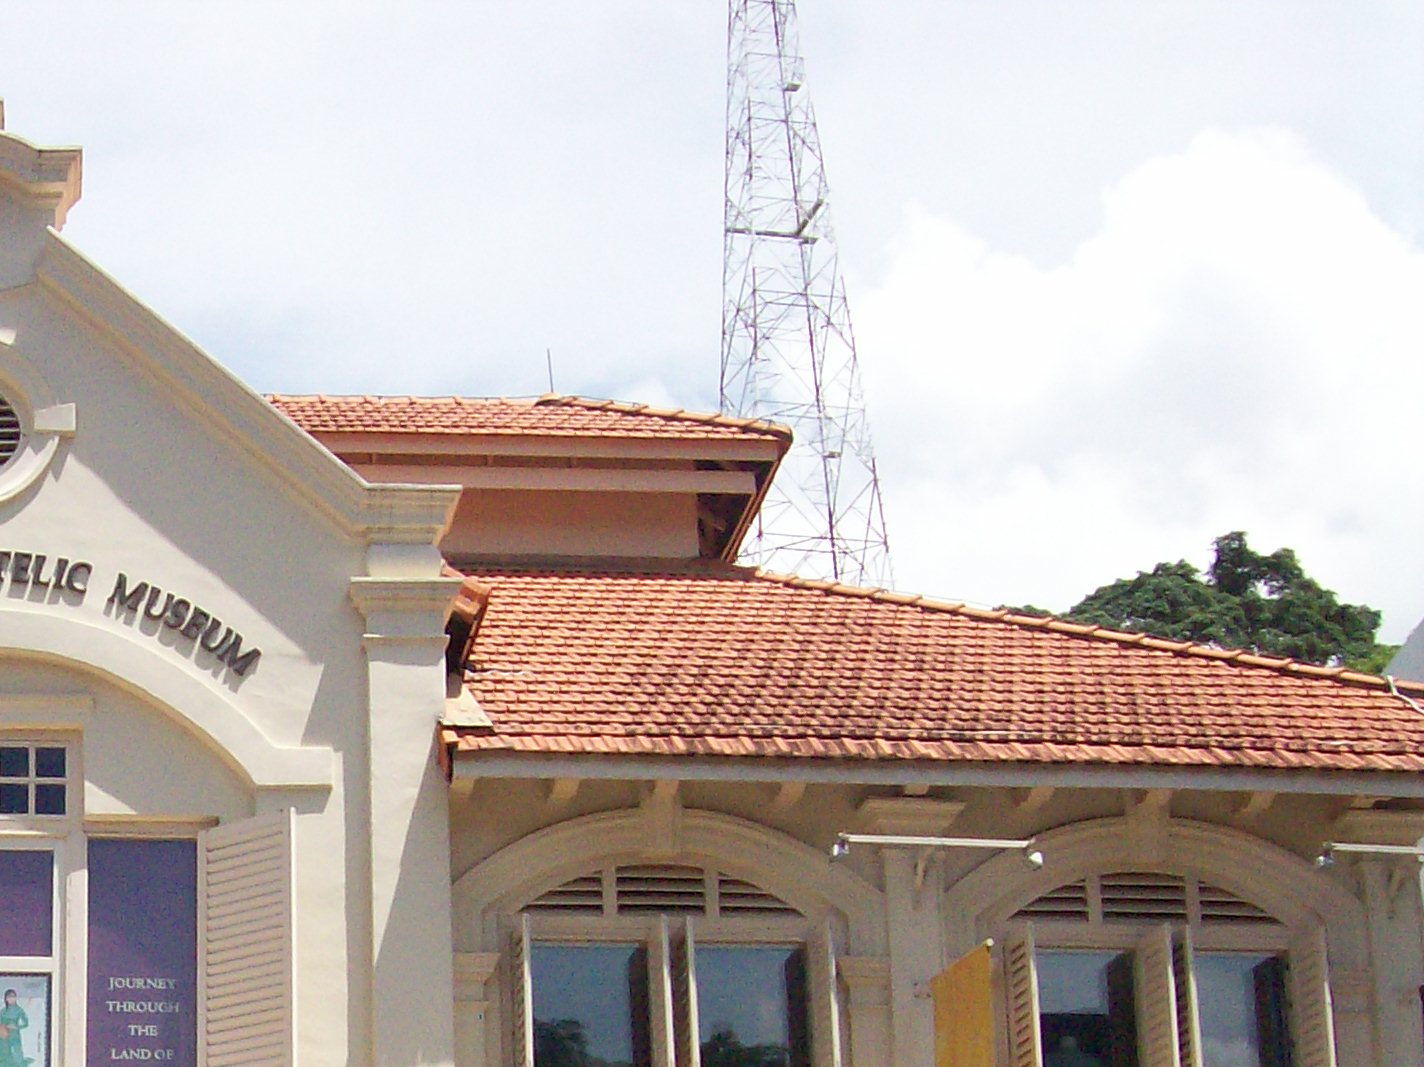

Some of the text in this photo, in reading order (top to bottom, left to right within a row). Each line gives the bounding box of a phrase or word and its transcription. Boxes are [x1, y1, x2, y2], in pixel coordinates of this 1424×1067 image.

[109, 572, 263, 678] MUSEUM
[107, 977, 177, 991] JOURNEY
[105, 1001, 180, 1014] THROUGH
[127, 1024, 158, 1037] THE
[111, 1047, 175, 1061] LAND OF
